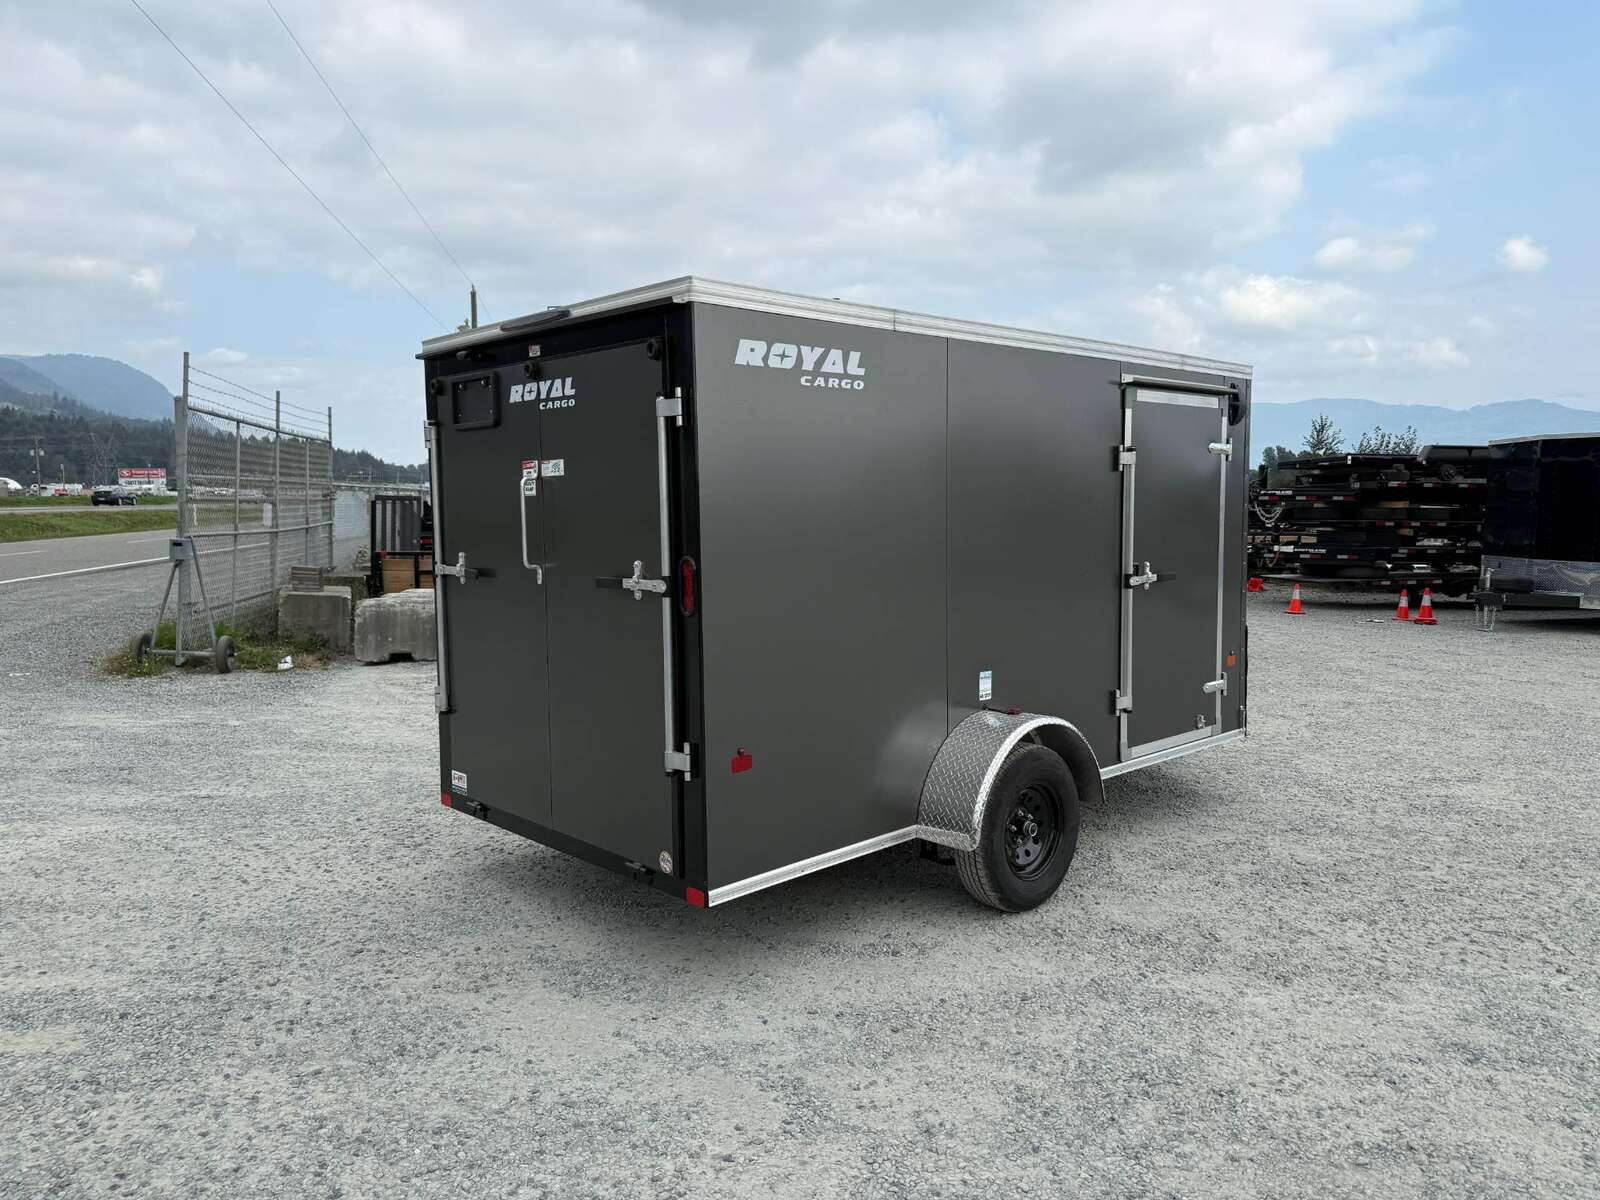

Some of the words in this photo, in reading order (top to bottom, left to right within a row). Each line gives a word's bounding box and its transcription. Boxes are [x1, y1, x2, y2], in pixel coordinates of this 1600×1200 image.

[735, 339, 865, 375] ROYAL
[509, 377, 576, 404] ROYAL
[800, 376, 864, 390] CARGO
[539, 399, 575, 410] CARGO
